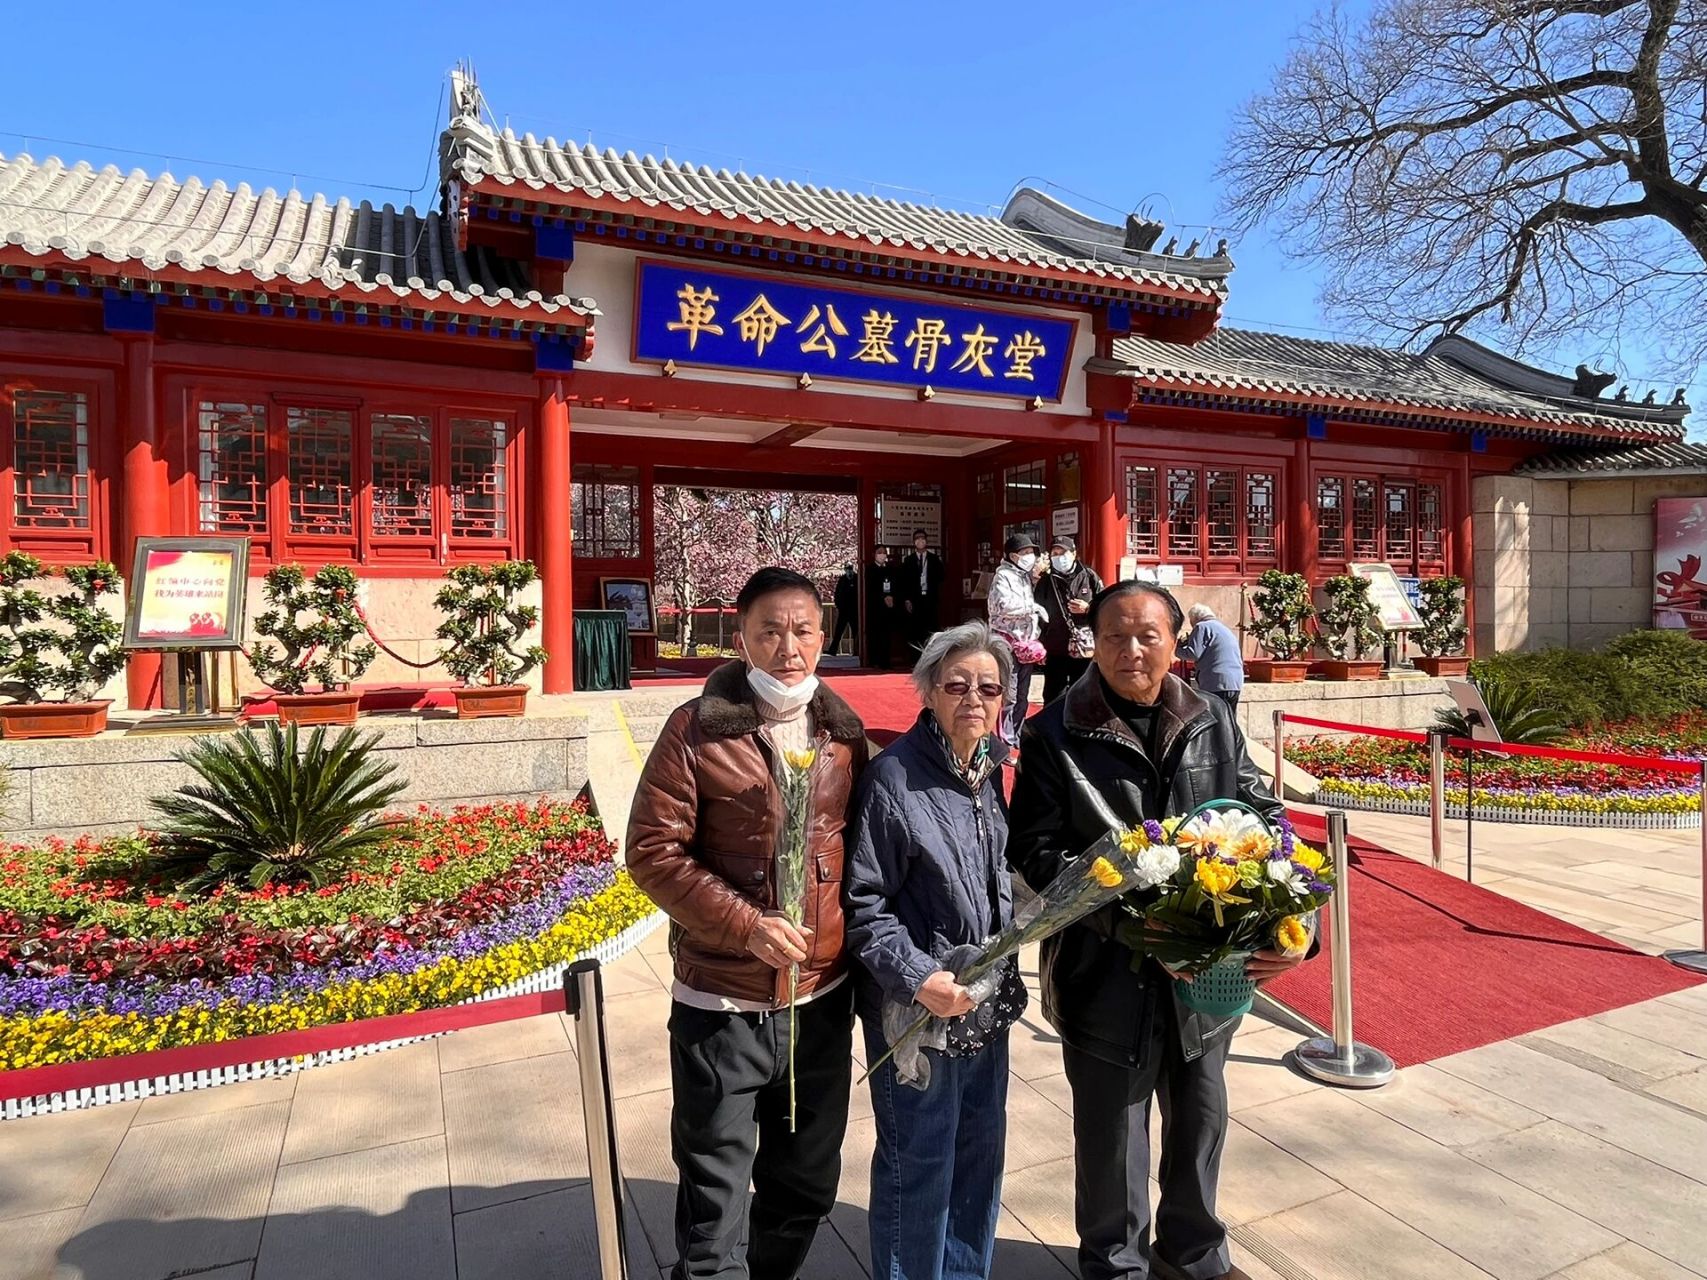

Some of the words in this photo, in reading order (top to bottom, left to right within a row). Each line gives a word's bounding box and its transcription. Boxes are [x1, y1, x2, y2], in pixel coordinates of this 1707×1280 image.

[667, 283, 1046, 381] 革命公墓骨灰堂
